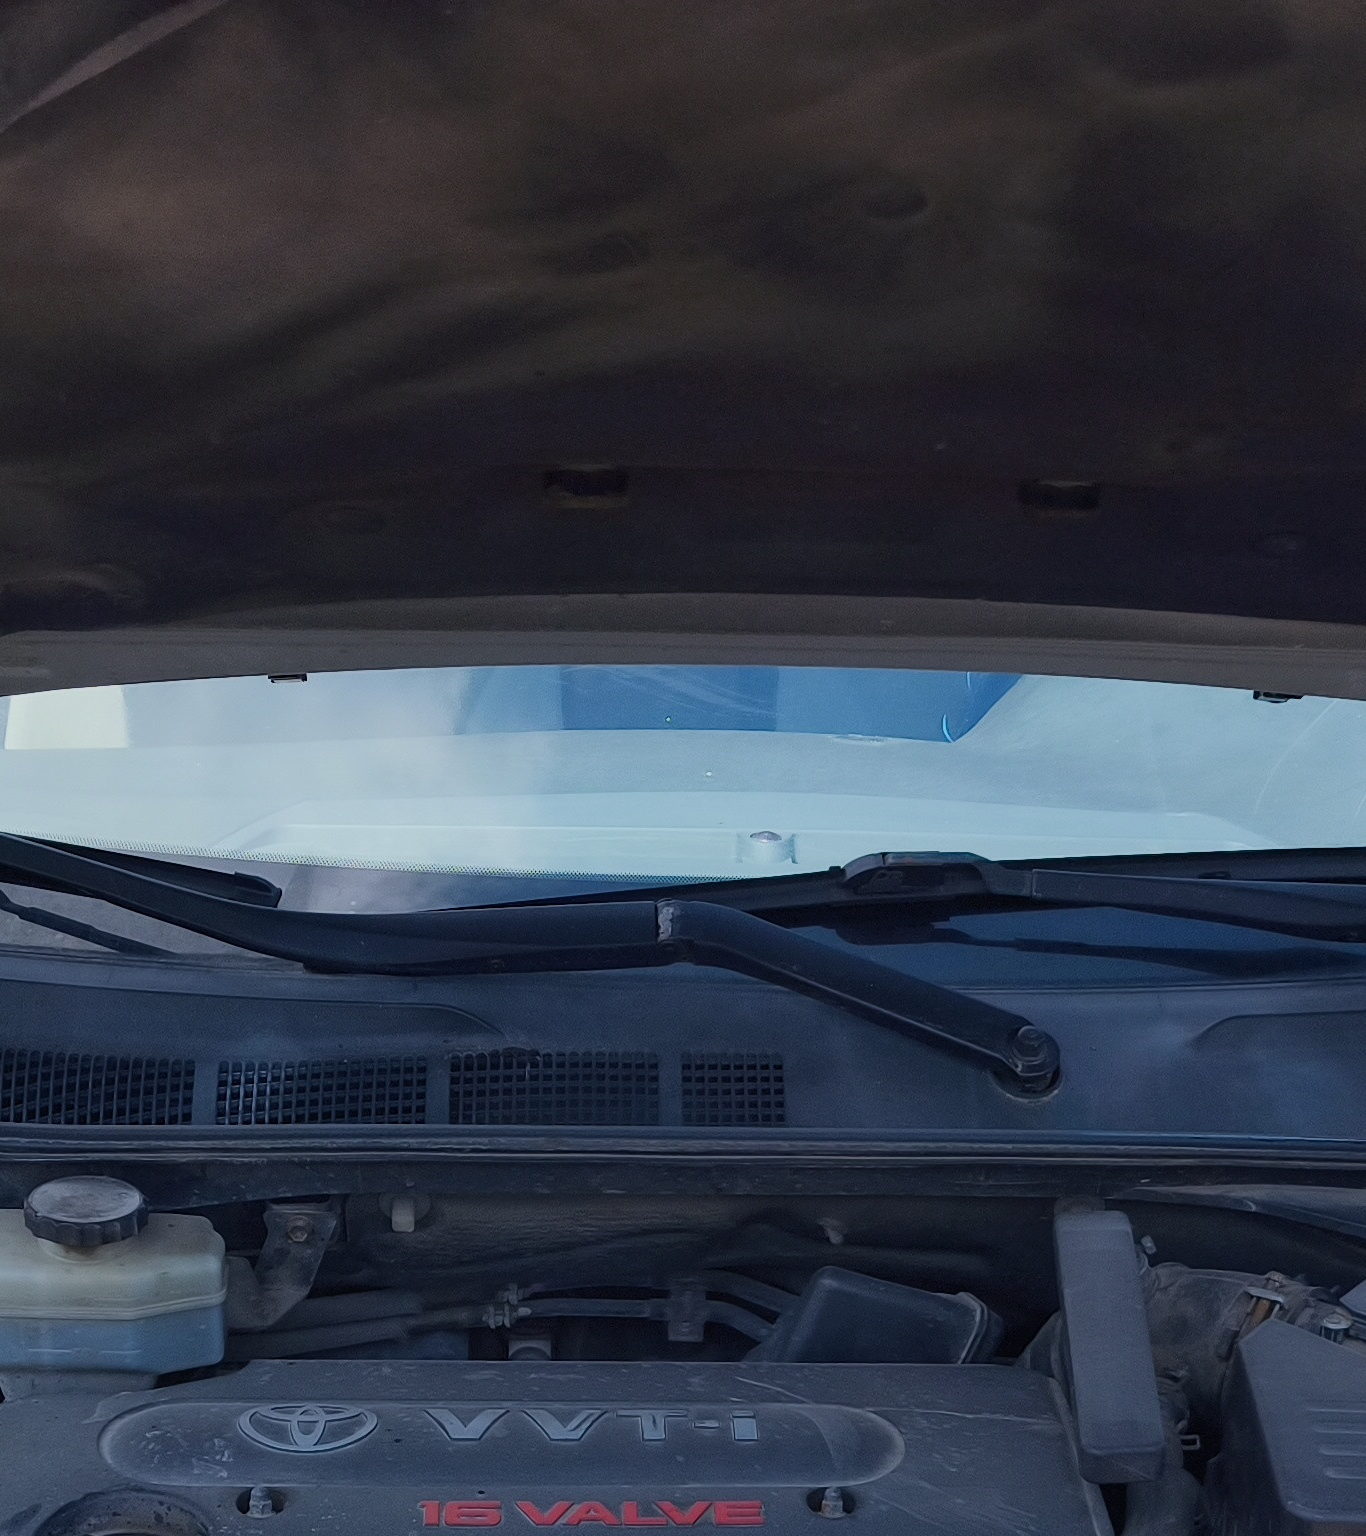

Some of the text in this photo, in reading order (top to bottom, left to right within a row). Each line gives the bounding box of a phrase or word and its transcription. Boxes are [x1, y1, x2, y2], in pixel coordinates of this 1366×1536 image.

[423, 1409, 760, 1442] VVT-i
[421, 1500, 767, 1527] 16 VALVE
